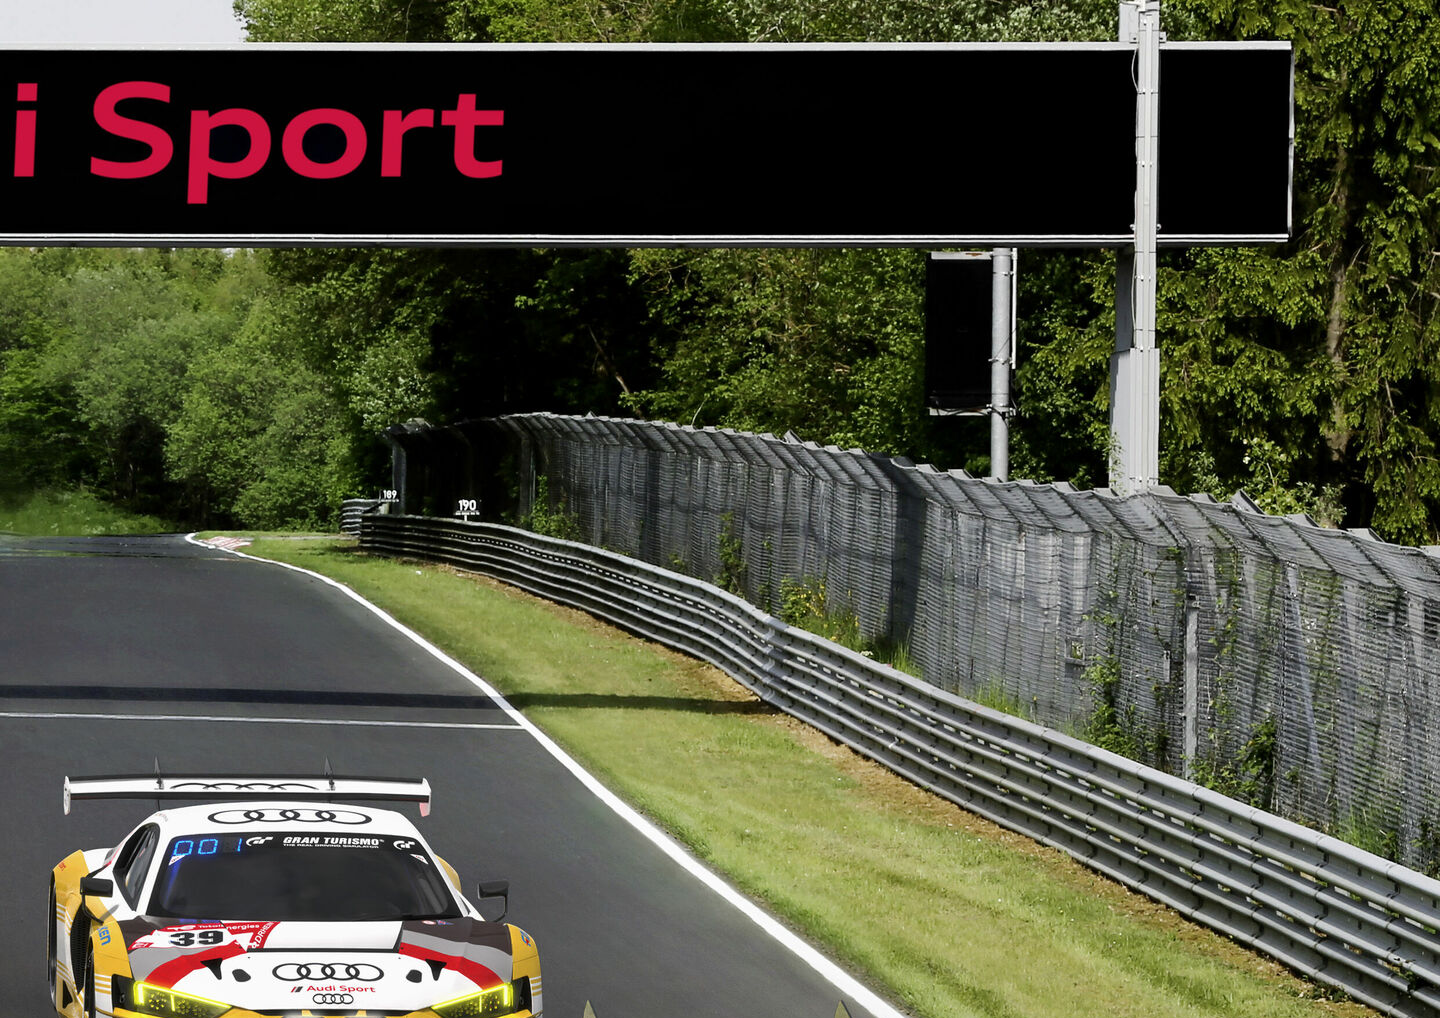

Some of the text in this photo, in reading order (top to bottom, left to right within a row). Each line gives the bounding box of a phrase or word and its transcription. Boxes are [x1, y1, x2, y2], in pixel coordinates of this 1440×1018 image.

[90, 80, 505, 204] Sport
[383, 489, 397, 499] 189
[458, 499, 476, 511] 190
[283, 836, 320, 844] GRAN
[169, 930, 224, 947] 39
[306, 984, 376, 993] Audi Sport
